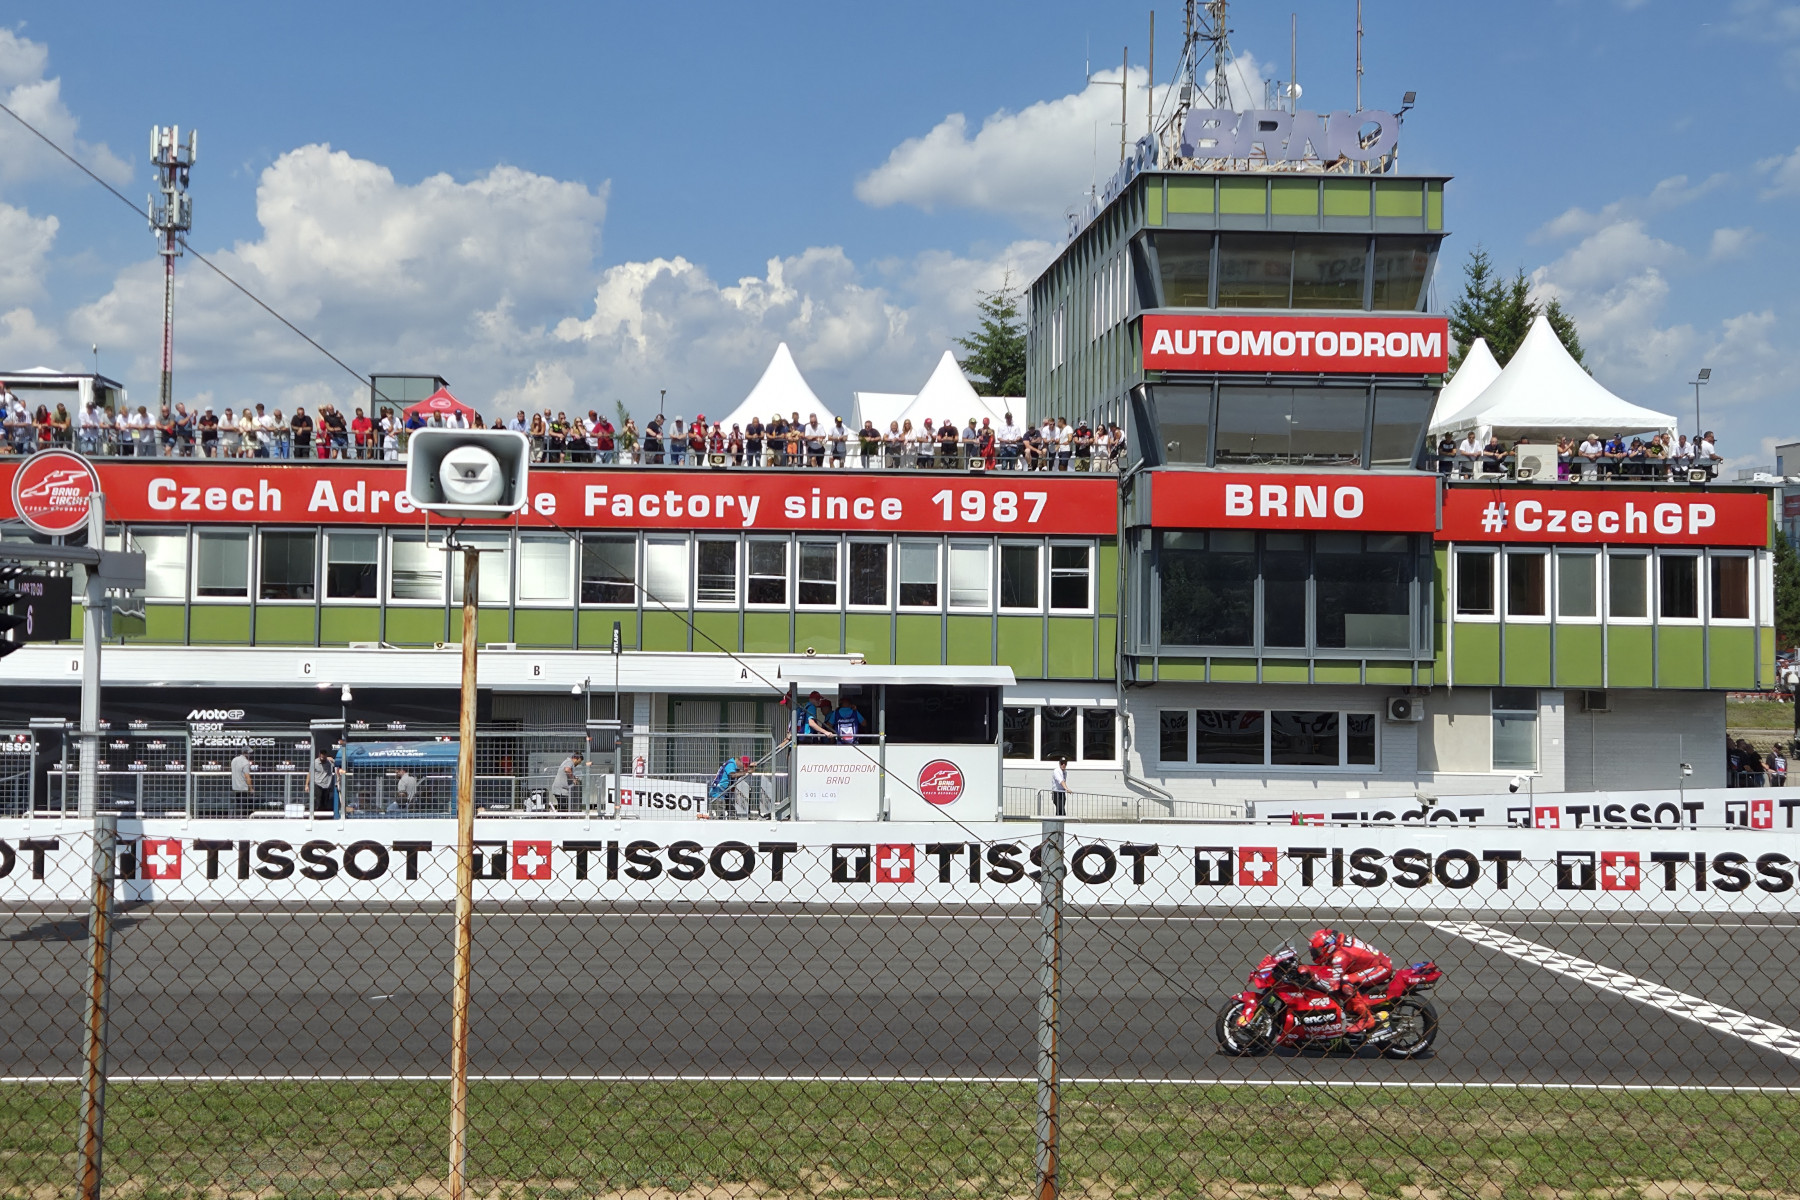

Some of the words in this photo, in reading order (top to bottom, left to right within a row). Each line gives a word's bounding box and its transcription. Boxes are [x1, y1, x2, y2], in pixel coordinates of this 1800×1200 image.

[1179, 108, 1400, 162] BRNO
[1150, 329, 1443, 358] AUTOMOTODROM
[49, 496, 90, 506] CIRCUIT
[52, 487, 80, 496] BRNO
[147, 477, 282, 512] Czech
[584, 484, 762, 527] Factory
[784, 487, 903, 521] since
[931, 489, 1049, 523] 1987
[1225, 483, 1364, 519] BRNO
[1481, 500, 1717, 535] #CzechGP
[26, 604, 33, 635] 6
[71, 660, 79, 671] D
[303, 663, 311, 675] C
[533, 665, 541, 676] B
[740, 668, 748, 679] A
[186, 708, 245, 720] MotoGP
[190, 723, 224, 731] TISSOT
[204, 738, 248, 746] CZECHIA
[248, 738, 276, 746] 2025
[800, 764, 876, 774] AUTOMOTODROM
[825, 776, 851, 785] BRNO
[634, 789, 706, 812] TISSOT
[1565, 802, 1705, 831] TISSOT
[192, 839, 433, 881] TISSOT
[562, 839, 798, 882] TISSOT
[1287, 846, 1523, 889] TISSOT
[1650, 850, 1800, 894] TISS
